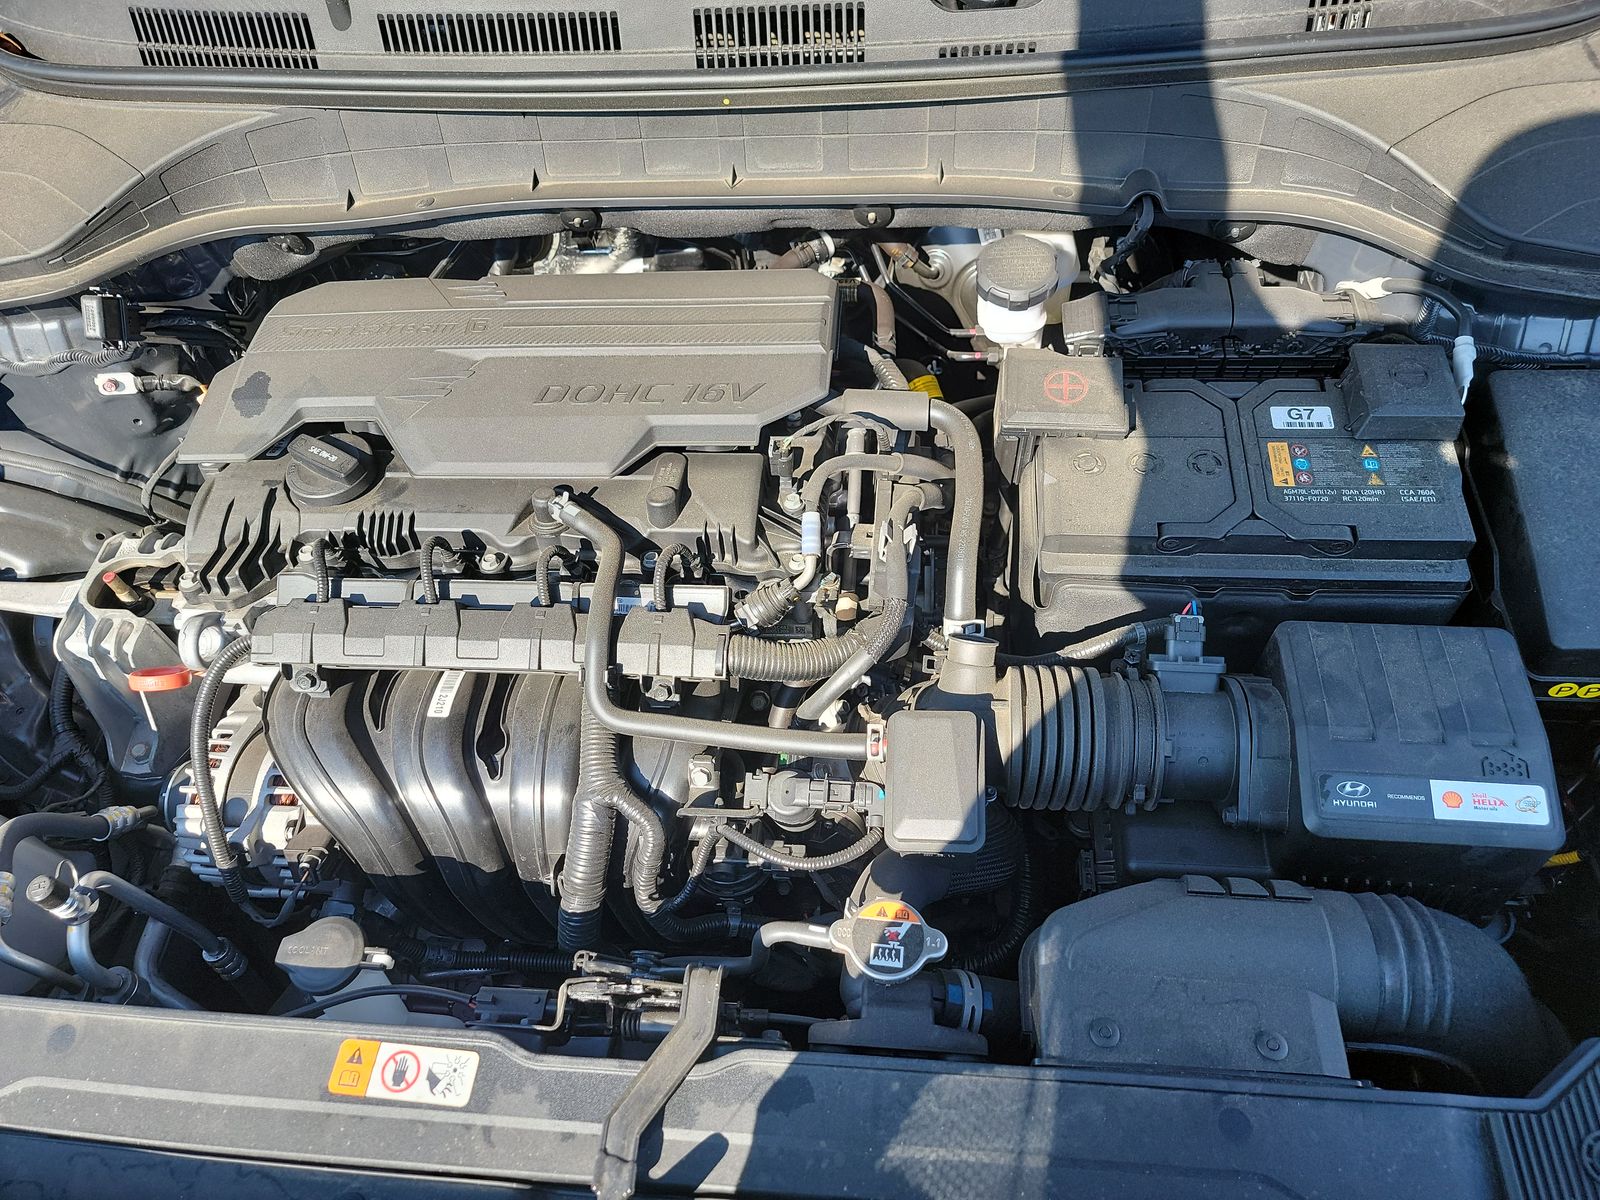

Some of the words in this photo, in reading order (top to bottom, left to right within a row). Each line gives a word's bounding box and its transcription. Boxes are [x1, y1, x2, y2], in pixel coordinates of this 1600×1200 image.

[532, 382, 674, 405] DOHC
[682, 382, 767, 404] 16V
[1287, 408, 1315, 421] G7
[1333, 799, 1378, 809] HYUNDAI
[1386, 793, 1426, 801] RECOMMENDS
[1472, 798, 1506, 807] HELIX
[287, 945, 329, 955] COOLANT
